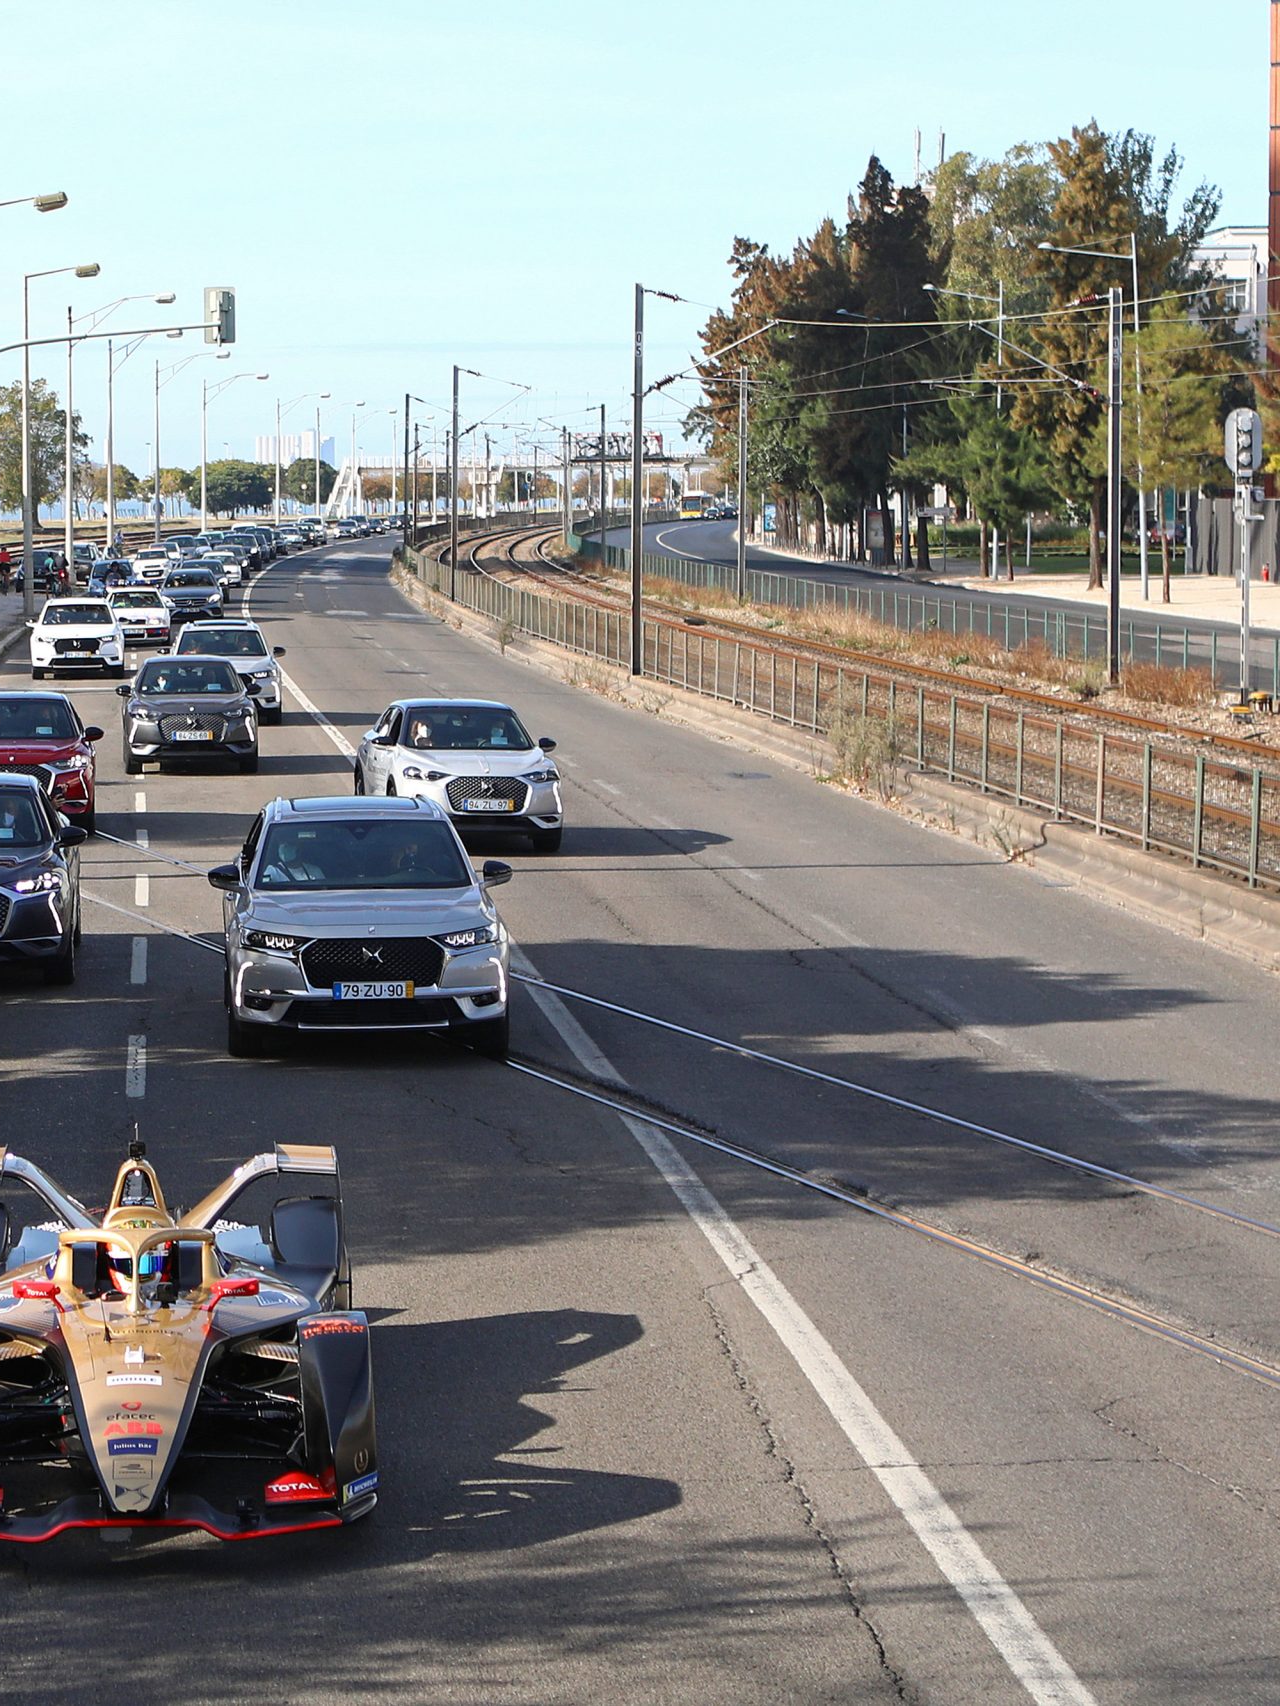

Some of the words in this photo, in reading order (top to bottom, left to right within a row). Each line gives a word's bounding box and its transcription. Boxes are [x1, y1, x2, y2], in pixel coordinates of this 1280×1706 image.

[106, 1412, 156, 1421] efacec
[103, 1421, 164, 1437] ABB
[268, 1482, 319, 1493] TOTAL
